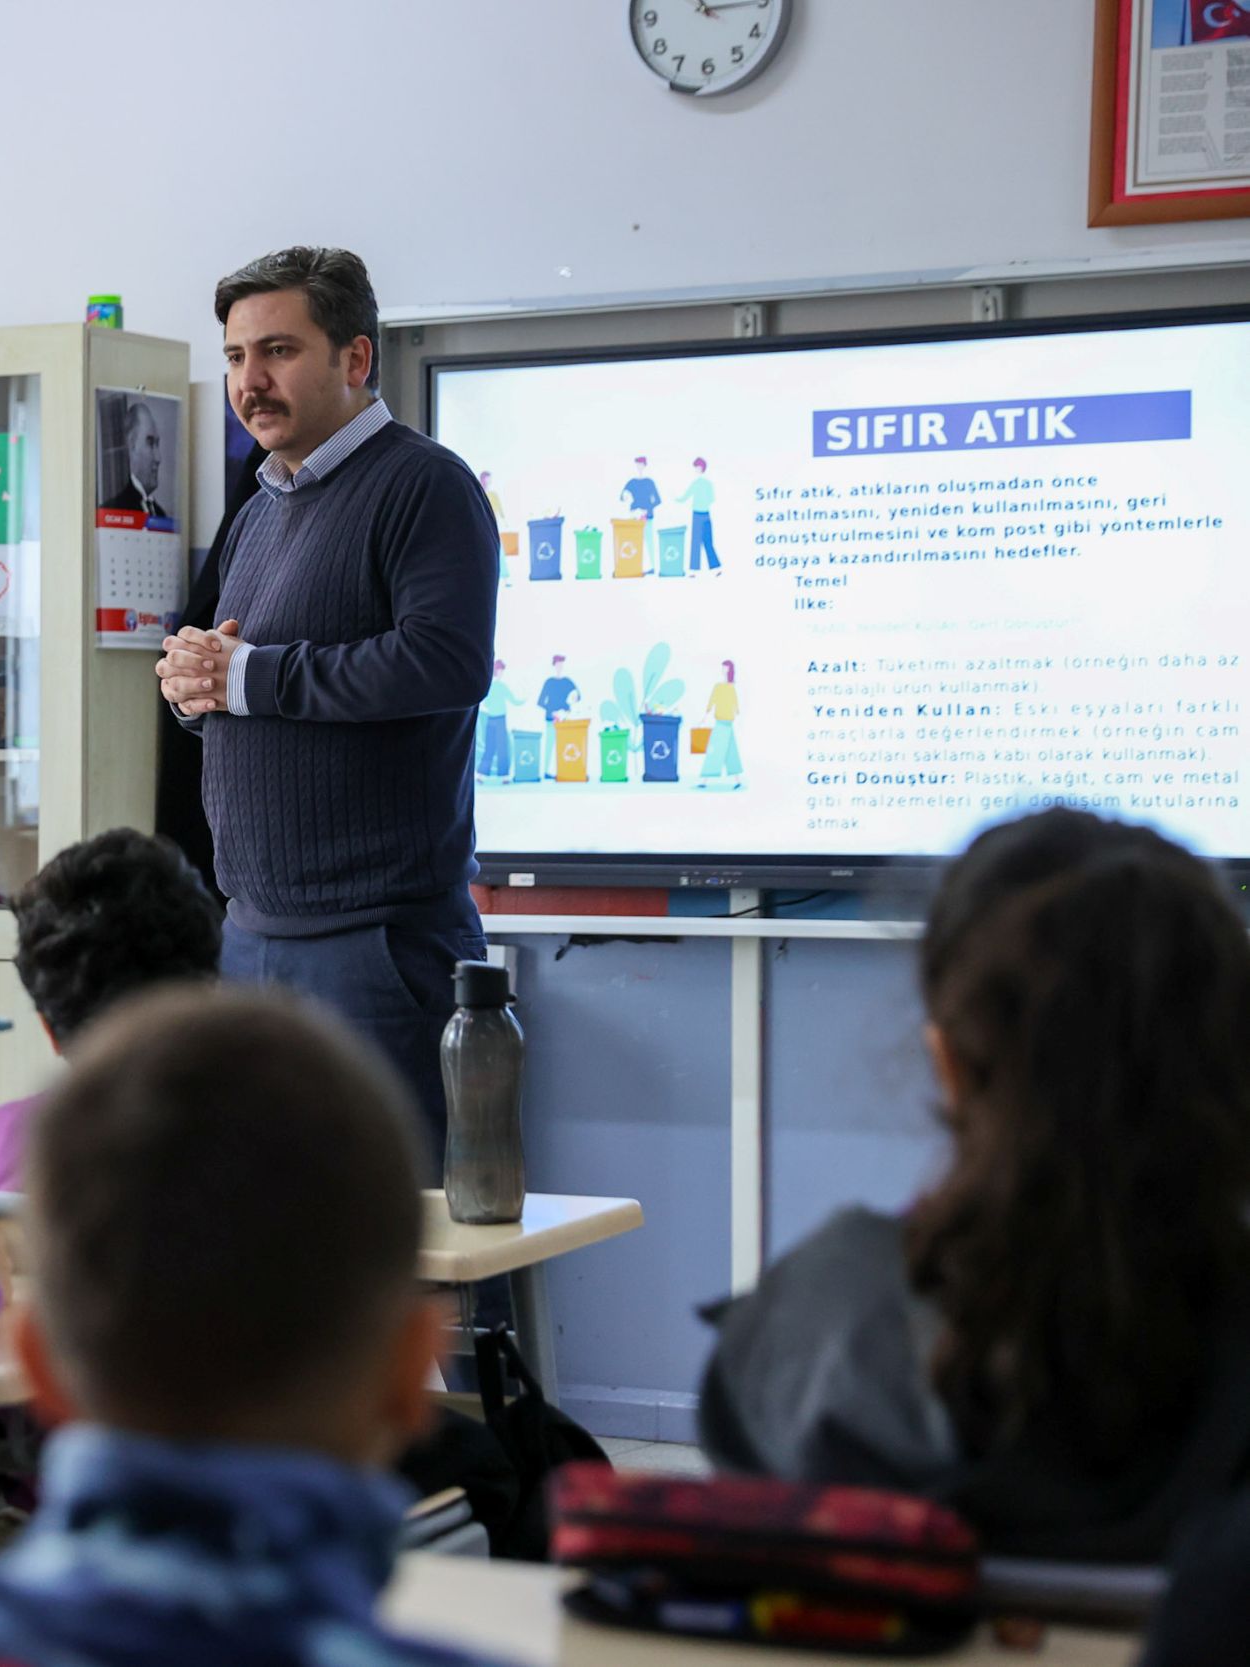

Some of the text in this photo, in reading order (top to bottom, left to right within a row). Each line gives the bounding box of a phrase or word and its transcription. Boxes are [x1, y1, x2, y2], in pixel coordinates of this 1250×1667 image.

[644, 10, 658, 27] 9
[749, 22, 761, 39] 4
[653, 38, 667, 55] 8
[731, 46, 744, 63] 5
[672, 55, 686, 72] 7
[702, 58, 715, 75] 6
[826, 404, 1077, 451] SIFIR ATIK
[755, 474, 1098, 501] Sıfır atık, atıkların oluşmadan önce
[755, 492, 1166, 524] azaltılmasını, yeniden kullanılmasını, geri
[927, 526, 949, 539] ve
[956, 523, 996, 538] kom
[1004, 522, 1046, 539] post
[1054, 518, 1091, 538] gibi
[1099, 514, 1223, 536] yöntemlerle
[755, 544, 1082, 569] doğaya kazandırılmasını hedefler.
[794, 574, 848, 588] Temel
[806, 660, 867, 674] Azalt:
[965, 656, 1054, 671] azaltmak
[1158, 653, 1208, 668] daha
[1217, 655, 1240, 667] az
[807, 680, 886, 697] ambalajlı
[813, 703, 904, 718] Yeniden
[916, 702, 1001, 717] Kullan:
[1070, 700, 1164, 718] eşyaları
[1176, 698, 1240, 714] farklı
[806, 726, 906, 742] amaçlarla
[1195, 724, 1240, 738] cam
[806, 750, 906, 763] kavanozları
[913, 749, 987, 763] saklama
[1037, 748, 1094, 762] olarak
[806, 770, 848, 785] Geri
[855, 769, 956, 787] Dönüştür:
[1104, 772, 1143, 785] cam
[1152, 772, 1175, 785] ve
[1183, 769, 1240, 785] metal
[980, 793, 1019, 810] geri
[1029, 791, 1121, 810] dönüşüm
[1130, 792, 1240, 808] kutularına
